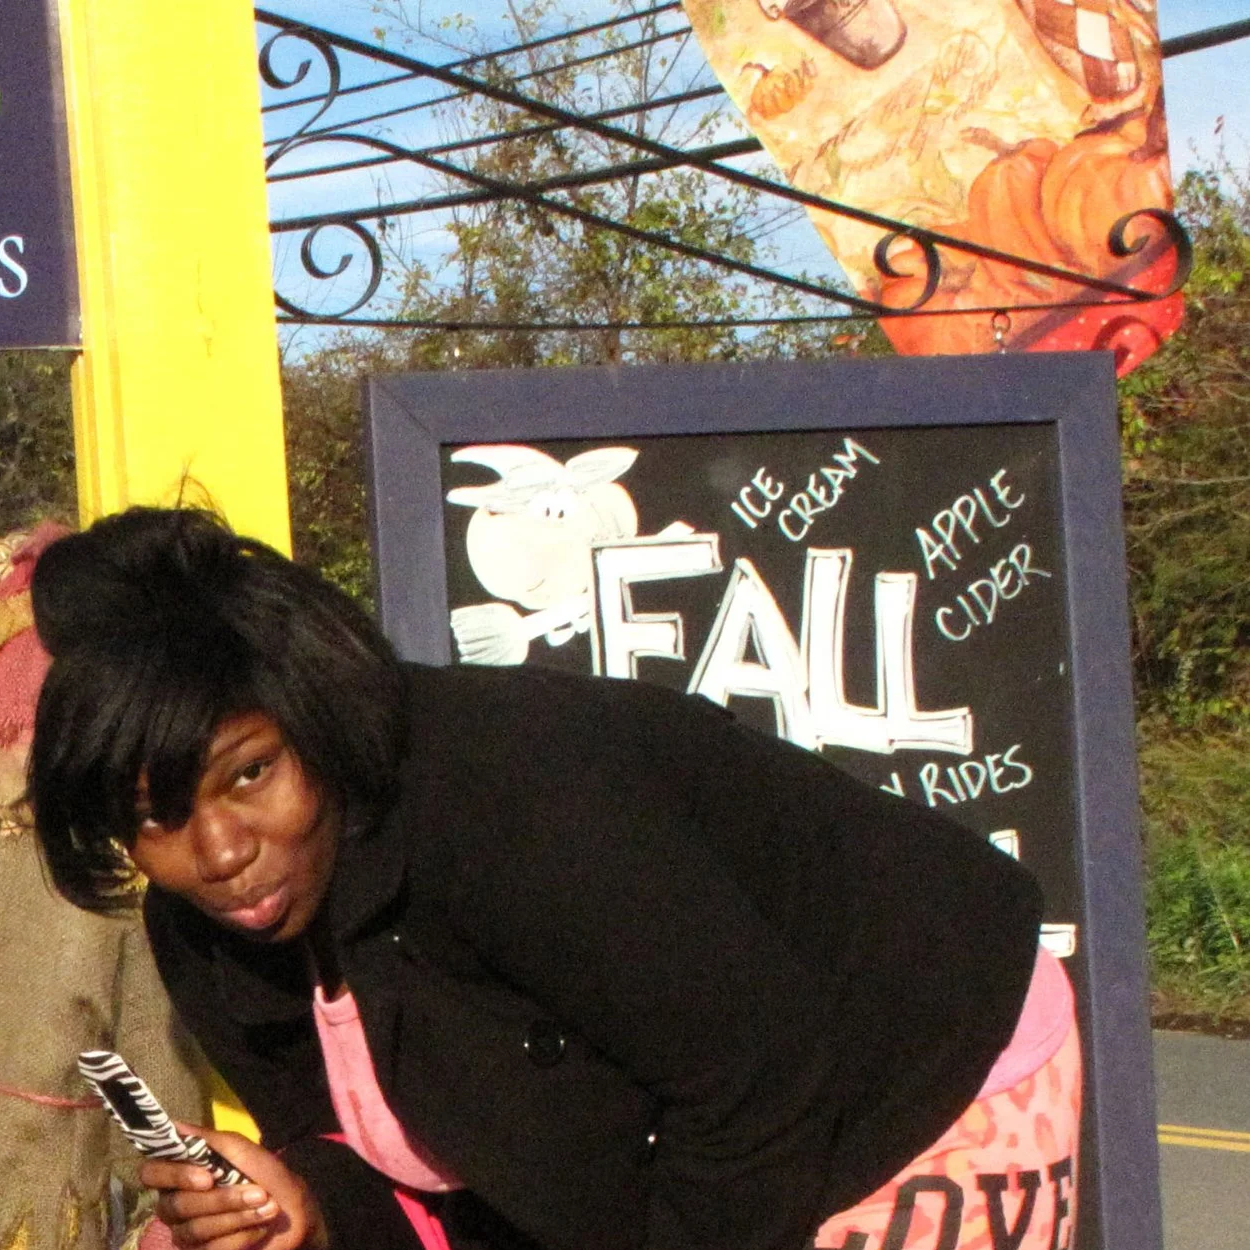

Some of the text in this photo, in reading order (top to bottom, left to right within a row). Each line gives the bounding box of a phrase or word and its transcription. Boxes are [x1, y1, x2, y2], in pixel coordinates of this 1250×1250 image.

[731, 466, 784, 528] ICE
[777, 438, 881, 542] CREAM
[915, 468, 1026, 580] APPLE
[935, 543, 1052, 641] CIDER
[590, 532, 974, 754] FALL
[919, 744, 1033, 808] RIDES
